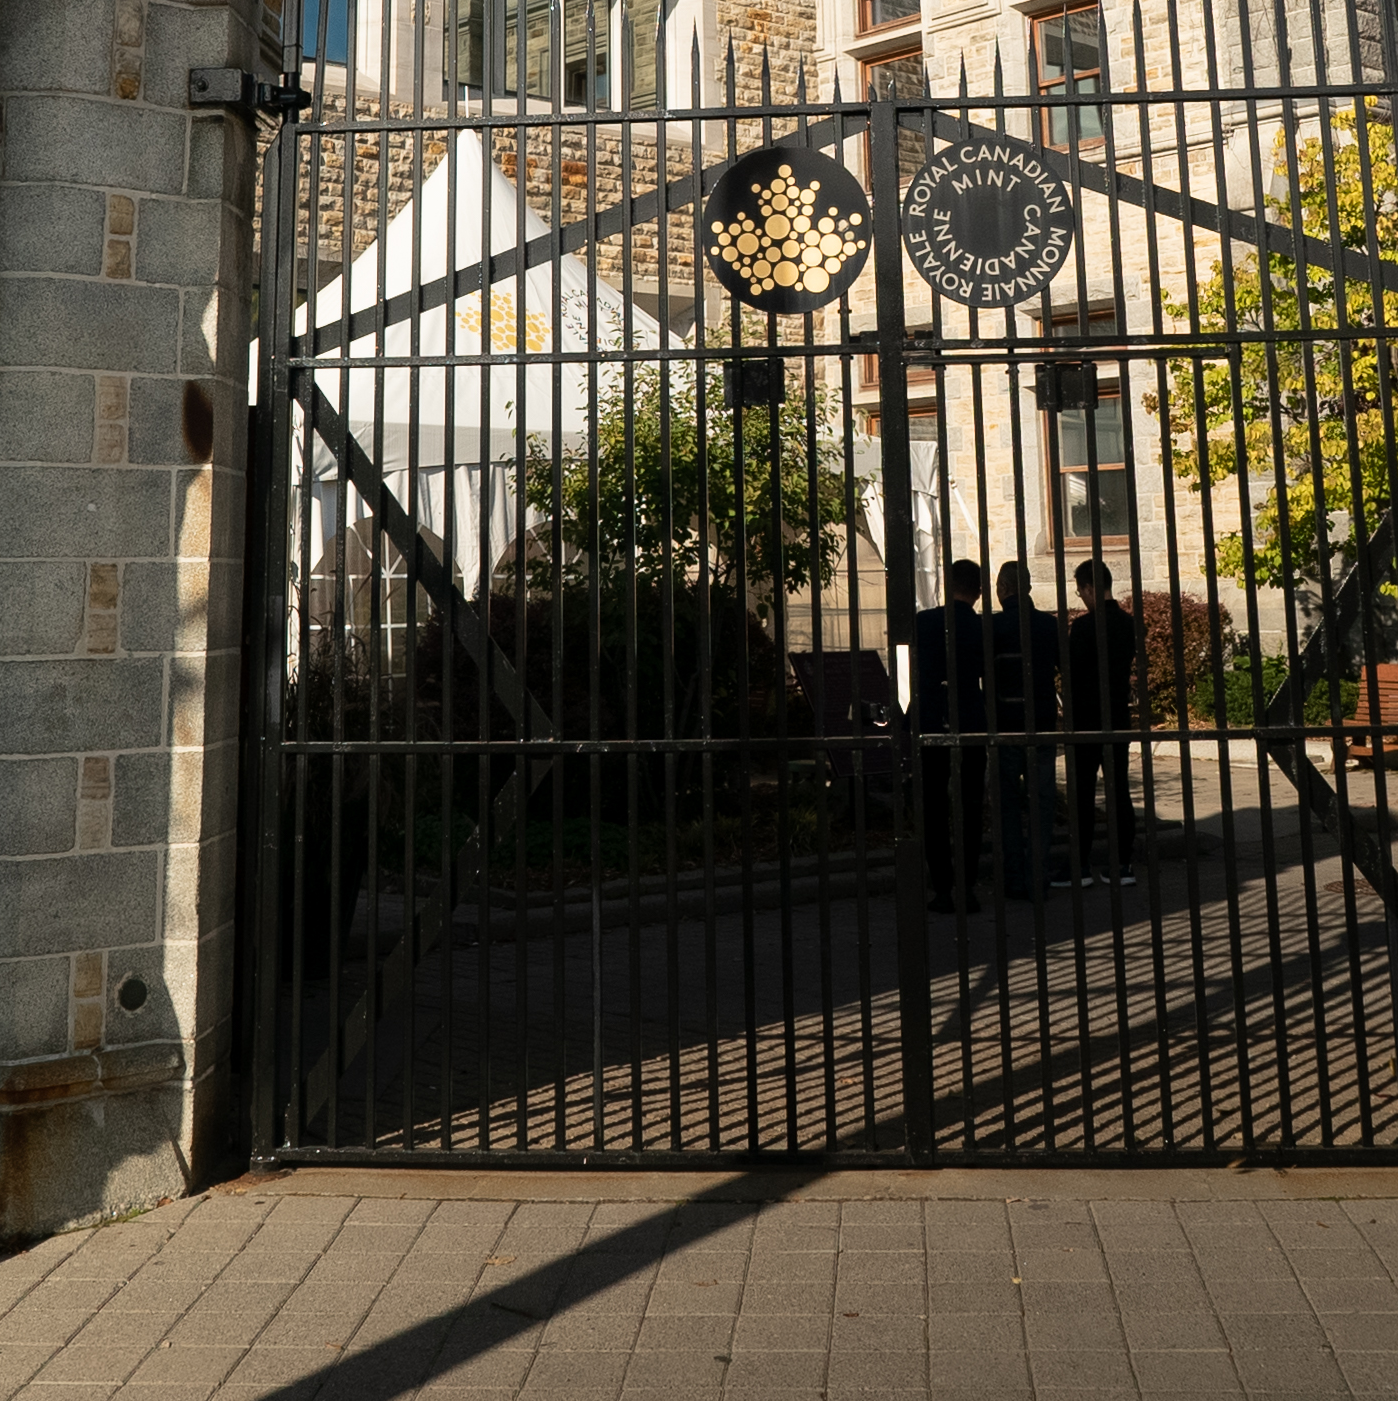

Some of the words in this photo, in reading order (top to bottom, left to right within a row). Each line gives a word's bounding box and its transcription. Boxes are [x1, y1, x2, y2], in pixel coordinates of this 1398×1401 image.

[909, 157, 958, 217] ROYAL
[960, 144, 1066, 214] CANADIAN
[951, 169, 1021, 195] MINT
[909, 230, 974, 298] ROYALE
[933, 204, 1041, 276] CANADIENNE
[981, 227, 1067, 301] MONNAIE
